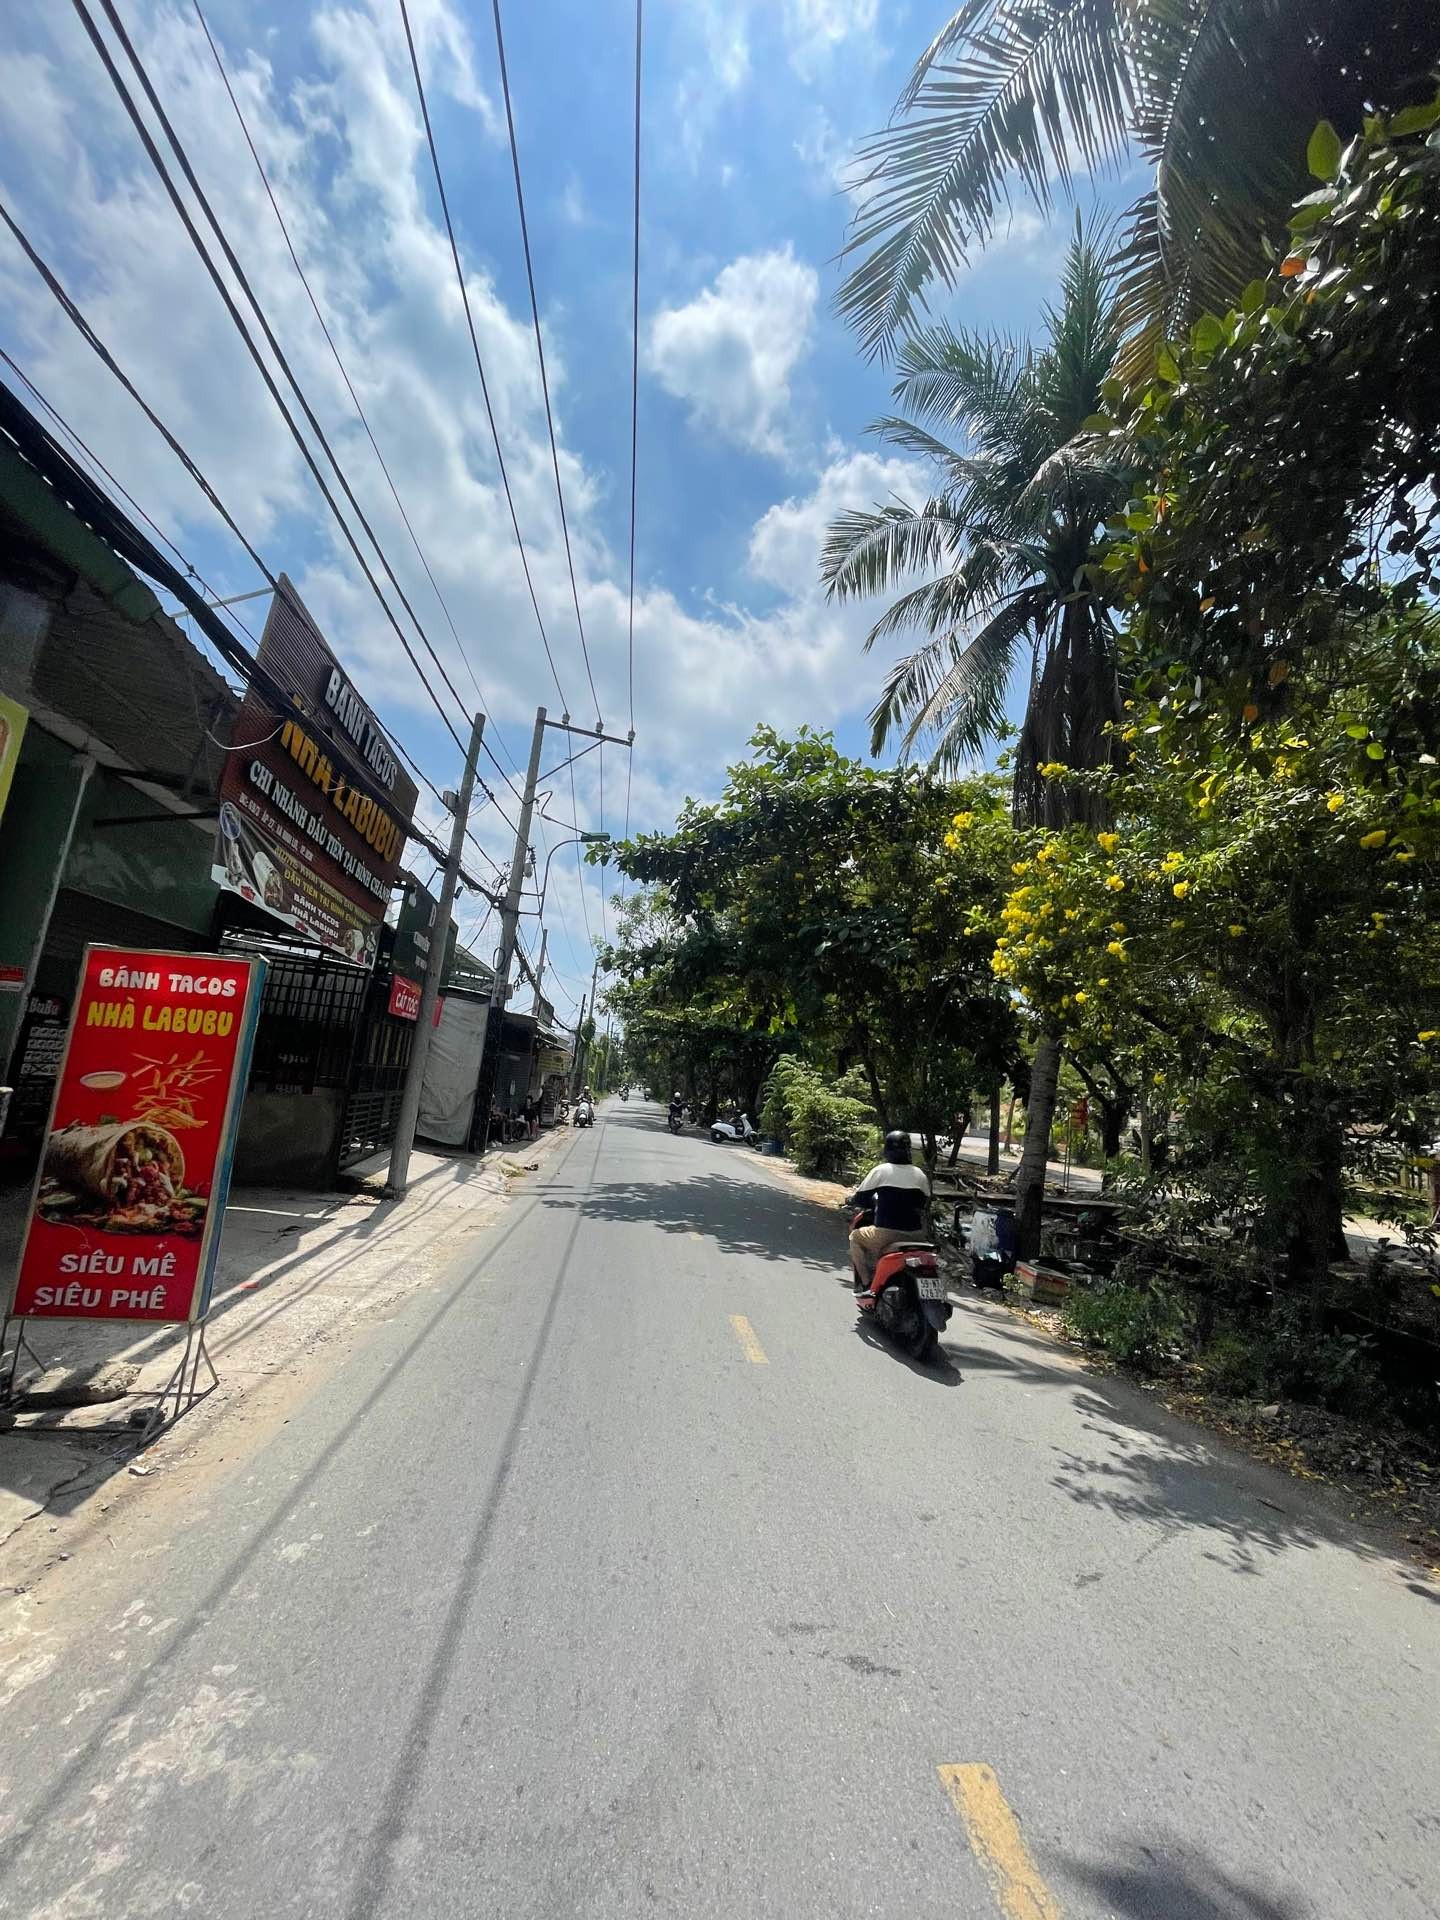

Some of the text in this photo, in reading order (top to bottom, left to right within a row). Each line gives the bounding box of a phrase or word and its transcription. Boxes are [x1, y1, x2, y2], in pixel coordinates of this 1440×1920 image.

[250, 760, 274, 795] CHI
[272, 780, 309, 830] NHÁNH
[99, 965, 237, 997] BÁNH TACOS
[86, 997, 234, 1037] NHÀ LABUBU
[59, 1248, 177, 1277] SIÊU MÊ
[34, 1281, 167, 1310] SIÊU PHÊ
